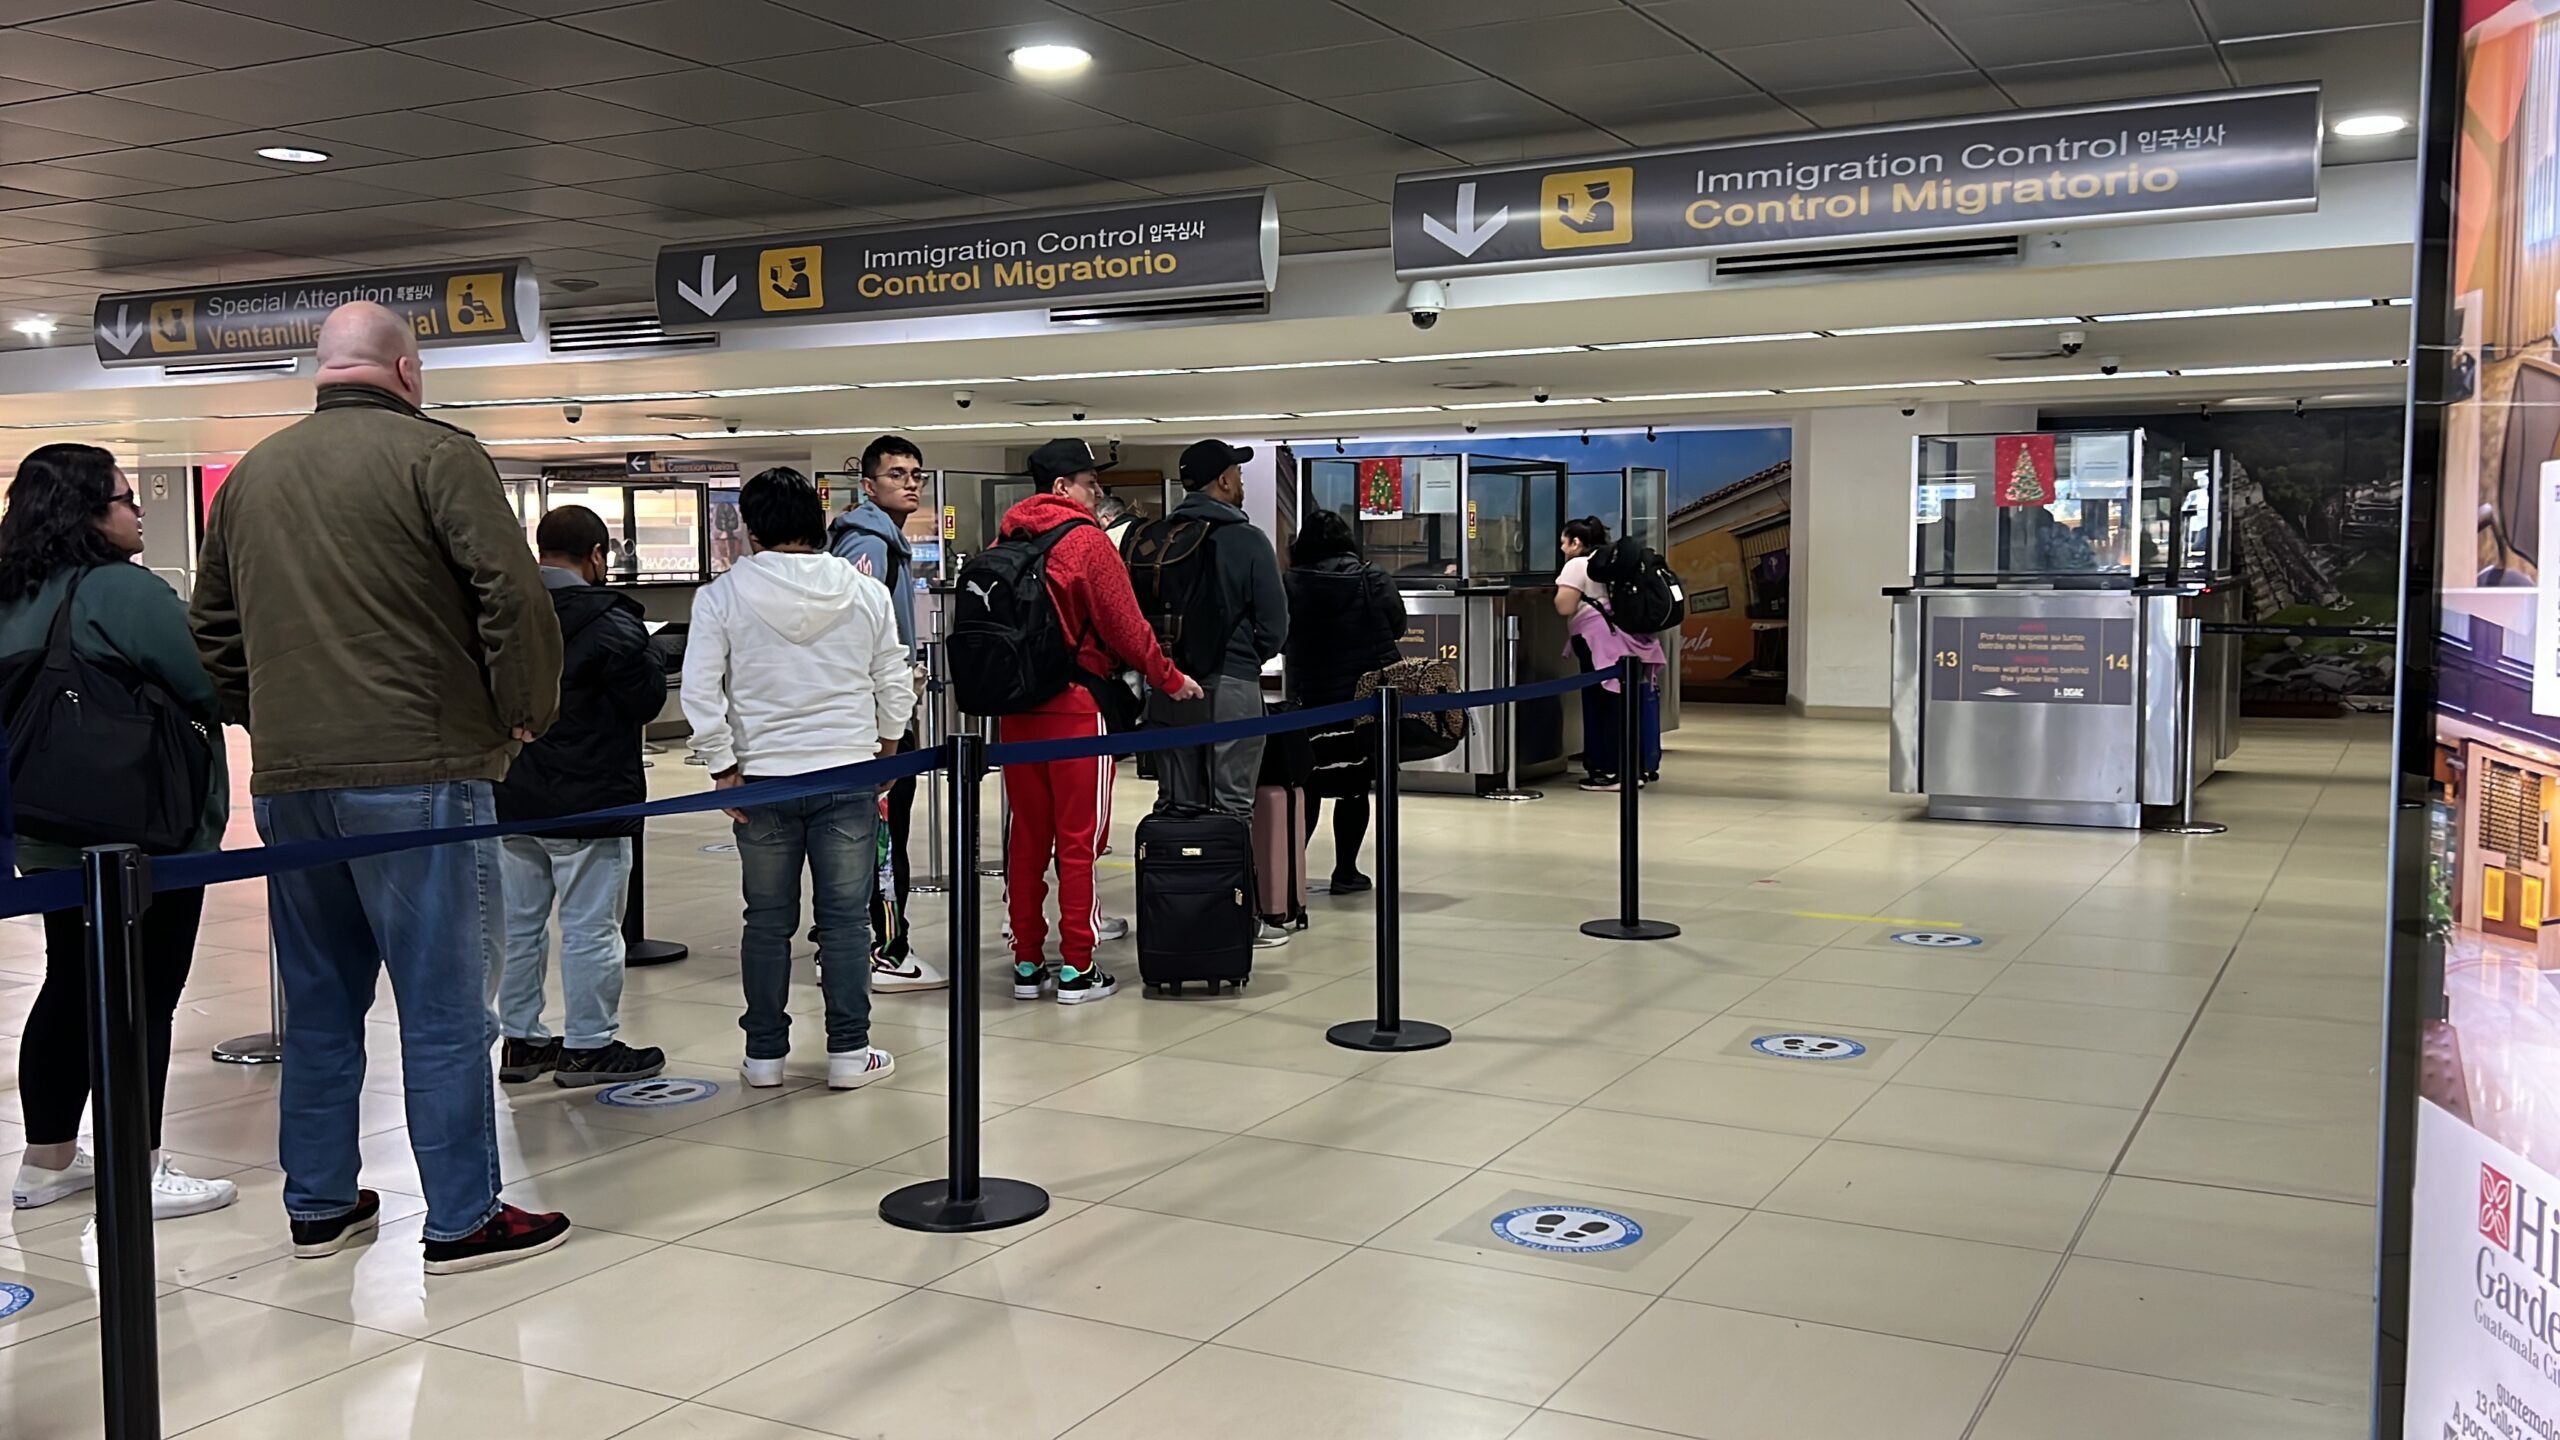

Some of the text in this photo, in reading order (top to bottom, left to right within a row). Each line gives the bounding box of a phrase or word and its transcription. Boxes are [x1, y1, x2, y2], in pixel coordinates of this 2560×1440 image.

[2137, 123, 2227, 154] 입국심사
[1696, 130, 2128, 194] Immigration Control
[1684, 163, 2179, 230] Control Migratorio
[864, 224, 1144, 269] Immigration Control
[1149, 220, 1206, 243] 입국심사
[857, 250, 1178, 299] Control Migratorio
[207, 284, 393, 320] Special Attention
[207, 318, 320, 350] Ventanilla
[1440, 645, 1457, 659] 12
[1935, 651, 1958, 668] 13
[2105, 653, 2129, 671] 14
[2513, 1184, 2560, 1288] Hi
[2476, 1247, 2560, 1355] Garde
[2474, 1298, 2540, 1370] Guatemala
[2453, 1401, 2461, 1425] A
[2476, 1390, 2488, 1416] 13
[2489, 1401, 2513, 1440] Calle
